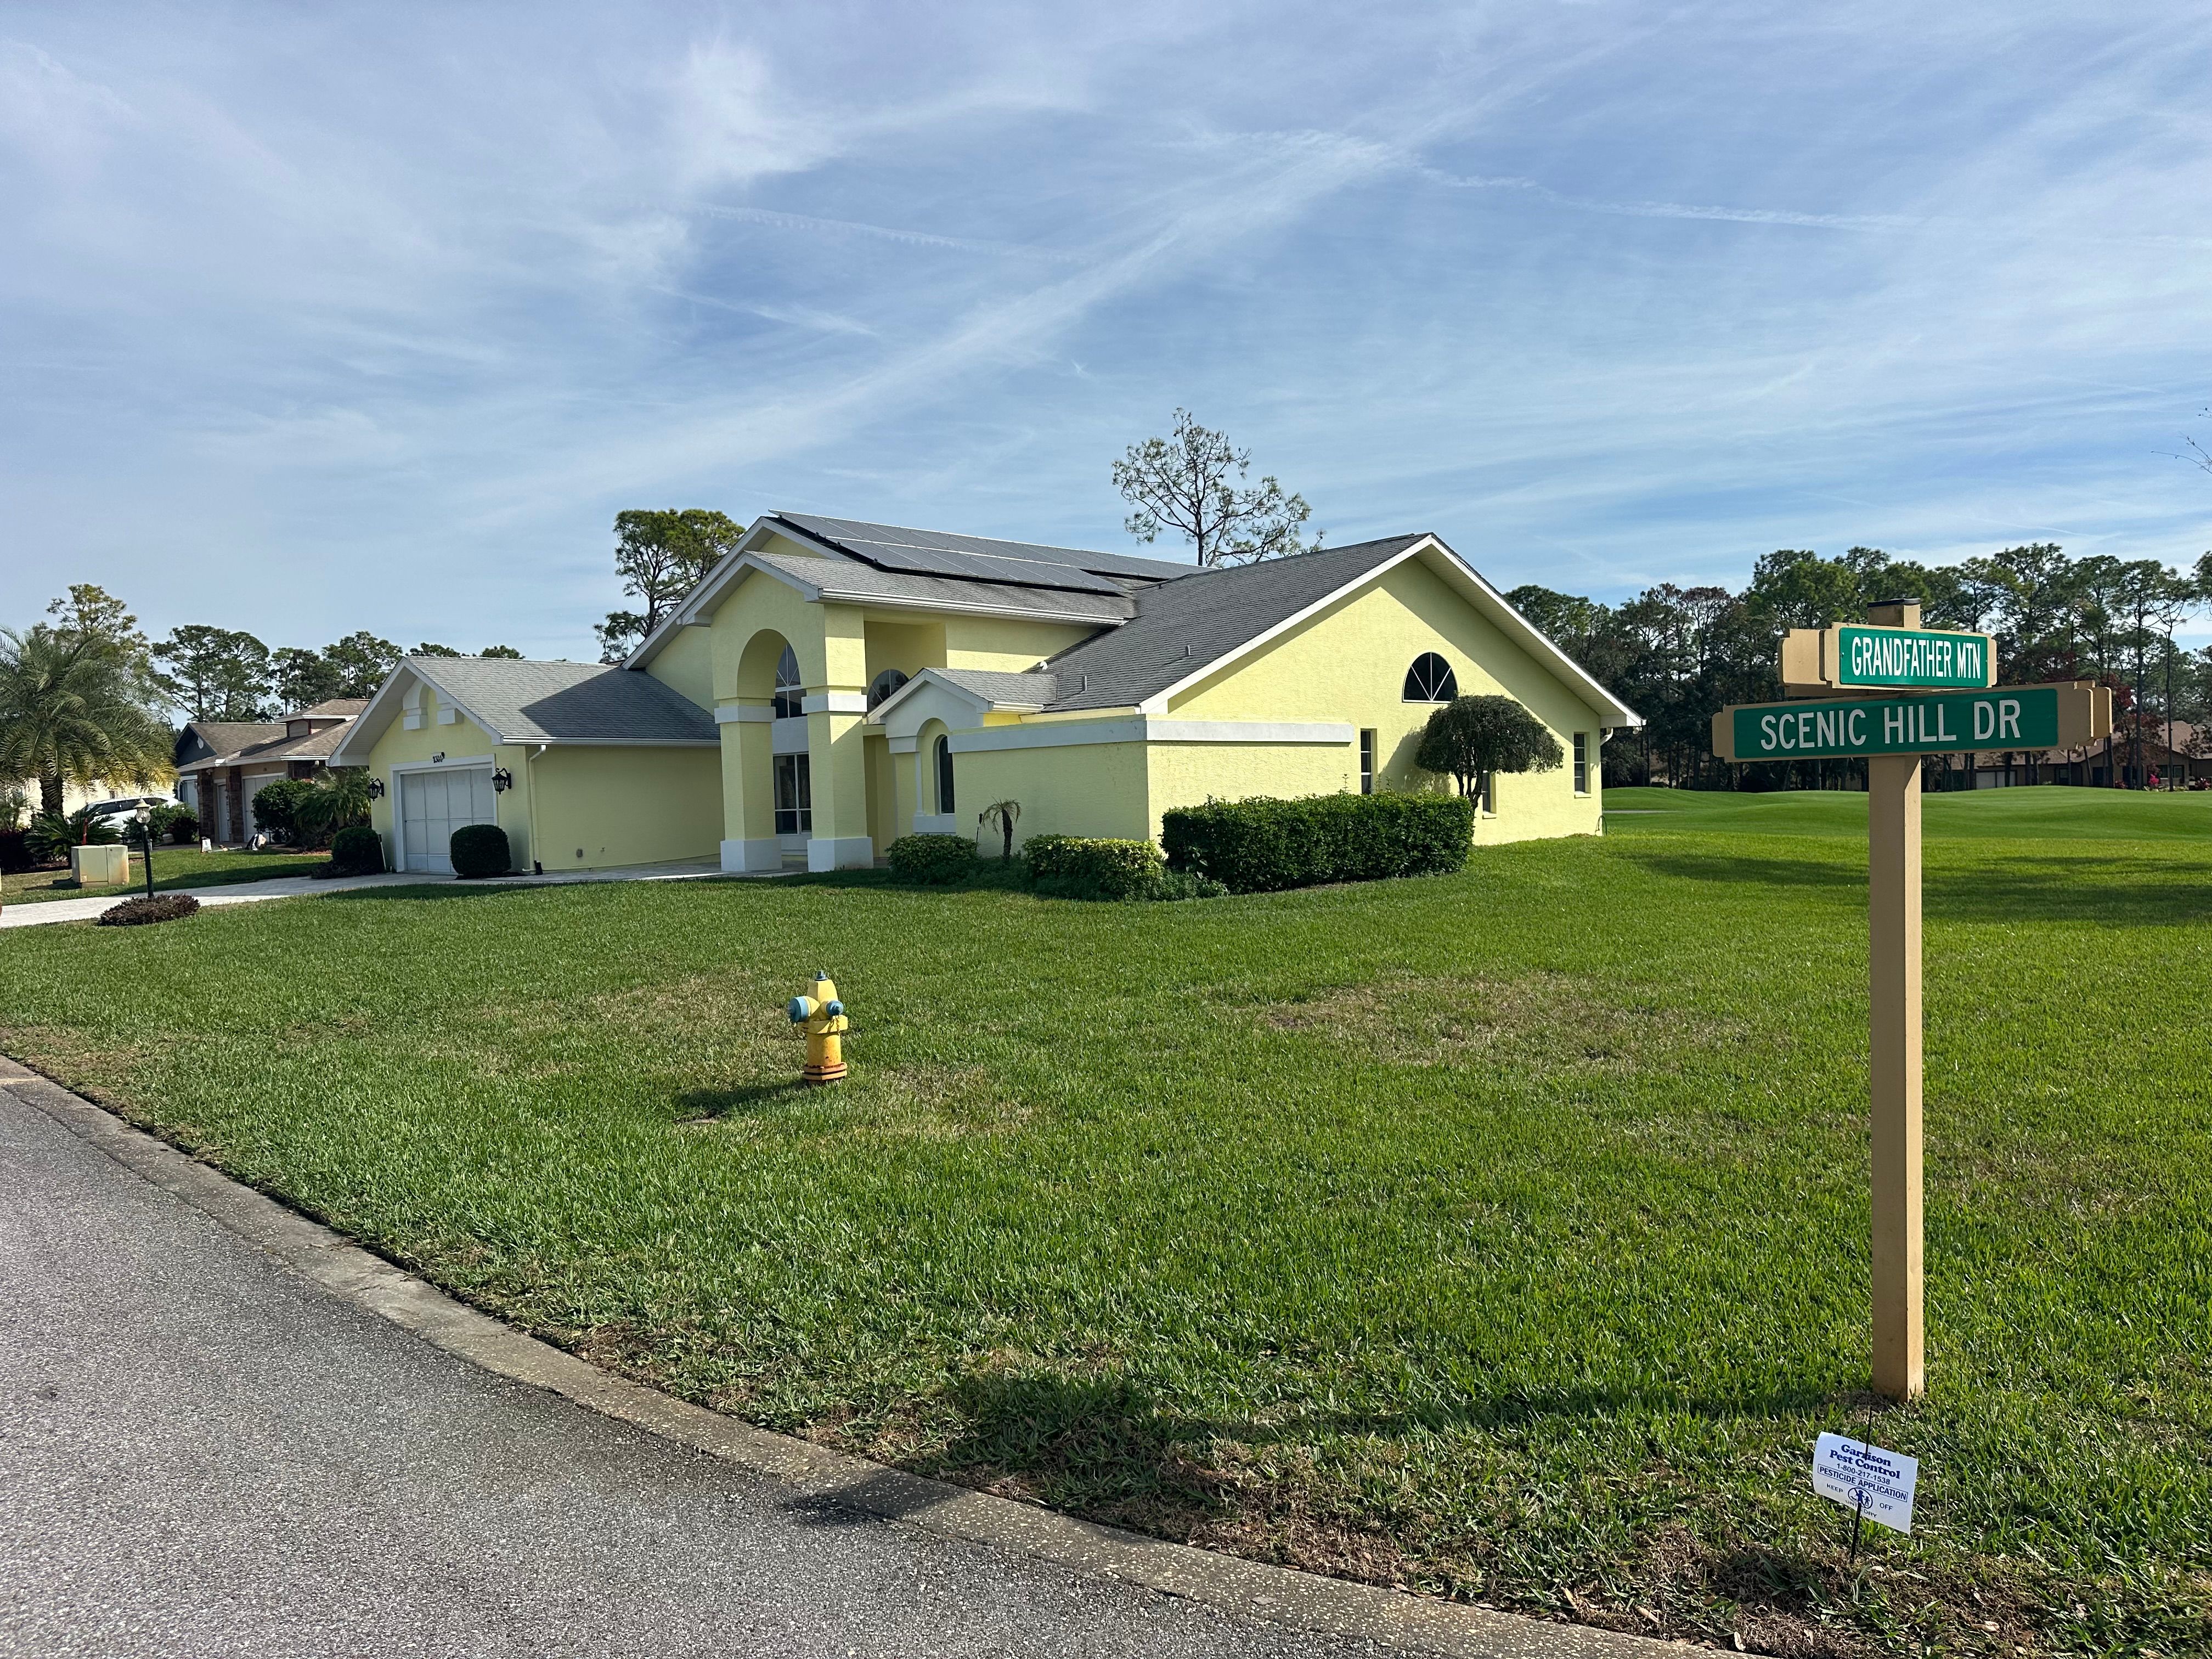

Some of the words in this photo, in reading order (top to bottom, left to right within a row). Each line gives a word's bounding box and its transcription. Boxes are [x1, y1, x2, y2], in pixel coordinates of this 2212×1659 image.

[1852, 636, 1952, 678] GRANDFATHER
[1956, 640, 1980, 679] MTN
[1760, 708, 1867, 750] SCENIC
[1883, 703, 1957, 744] HILL
[1974, 699, 2021, 741] DR
[1829, 1449, 1853, 1464] Pest
[1855, 1458, 1900, 1479] Control
[1836, 1463, 1891, 1485] 1-800-217-1538
[1819, 1466, 1856, 1484] PESTICIDE
[1858, 1481, 1906, 1500] APPLICATION
[1826, 1483, 1843, 1493] KEEP
[1879, 1503, 1894, 1511] OFF
[1864, 1509, 1877, 1517] DRY
